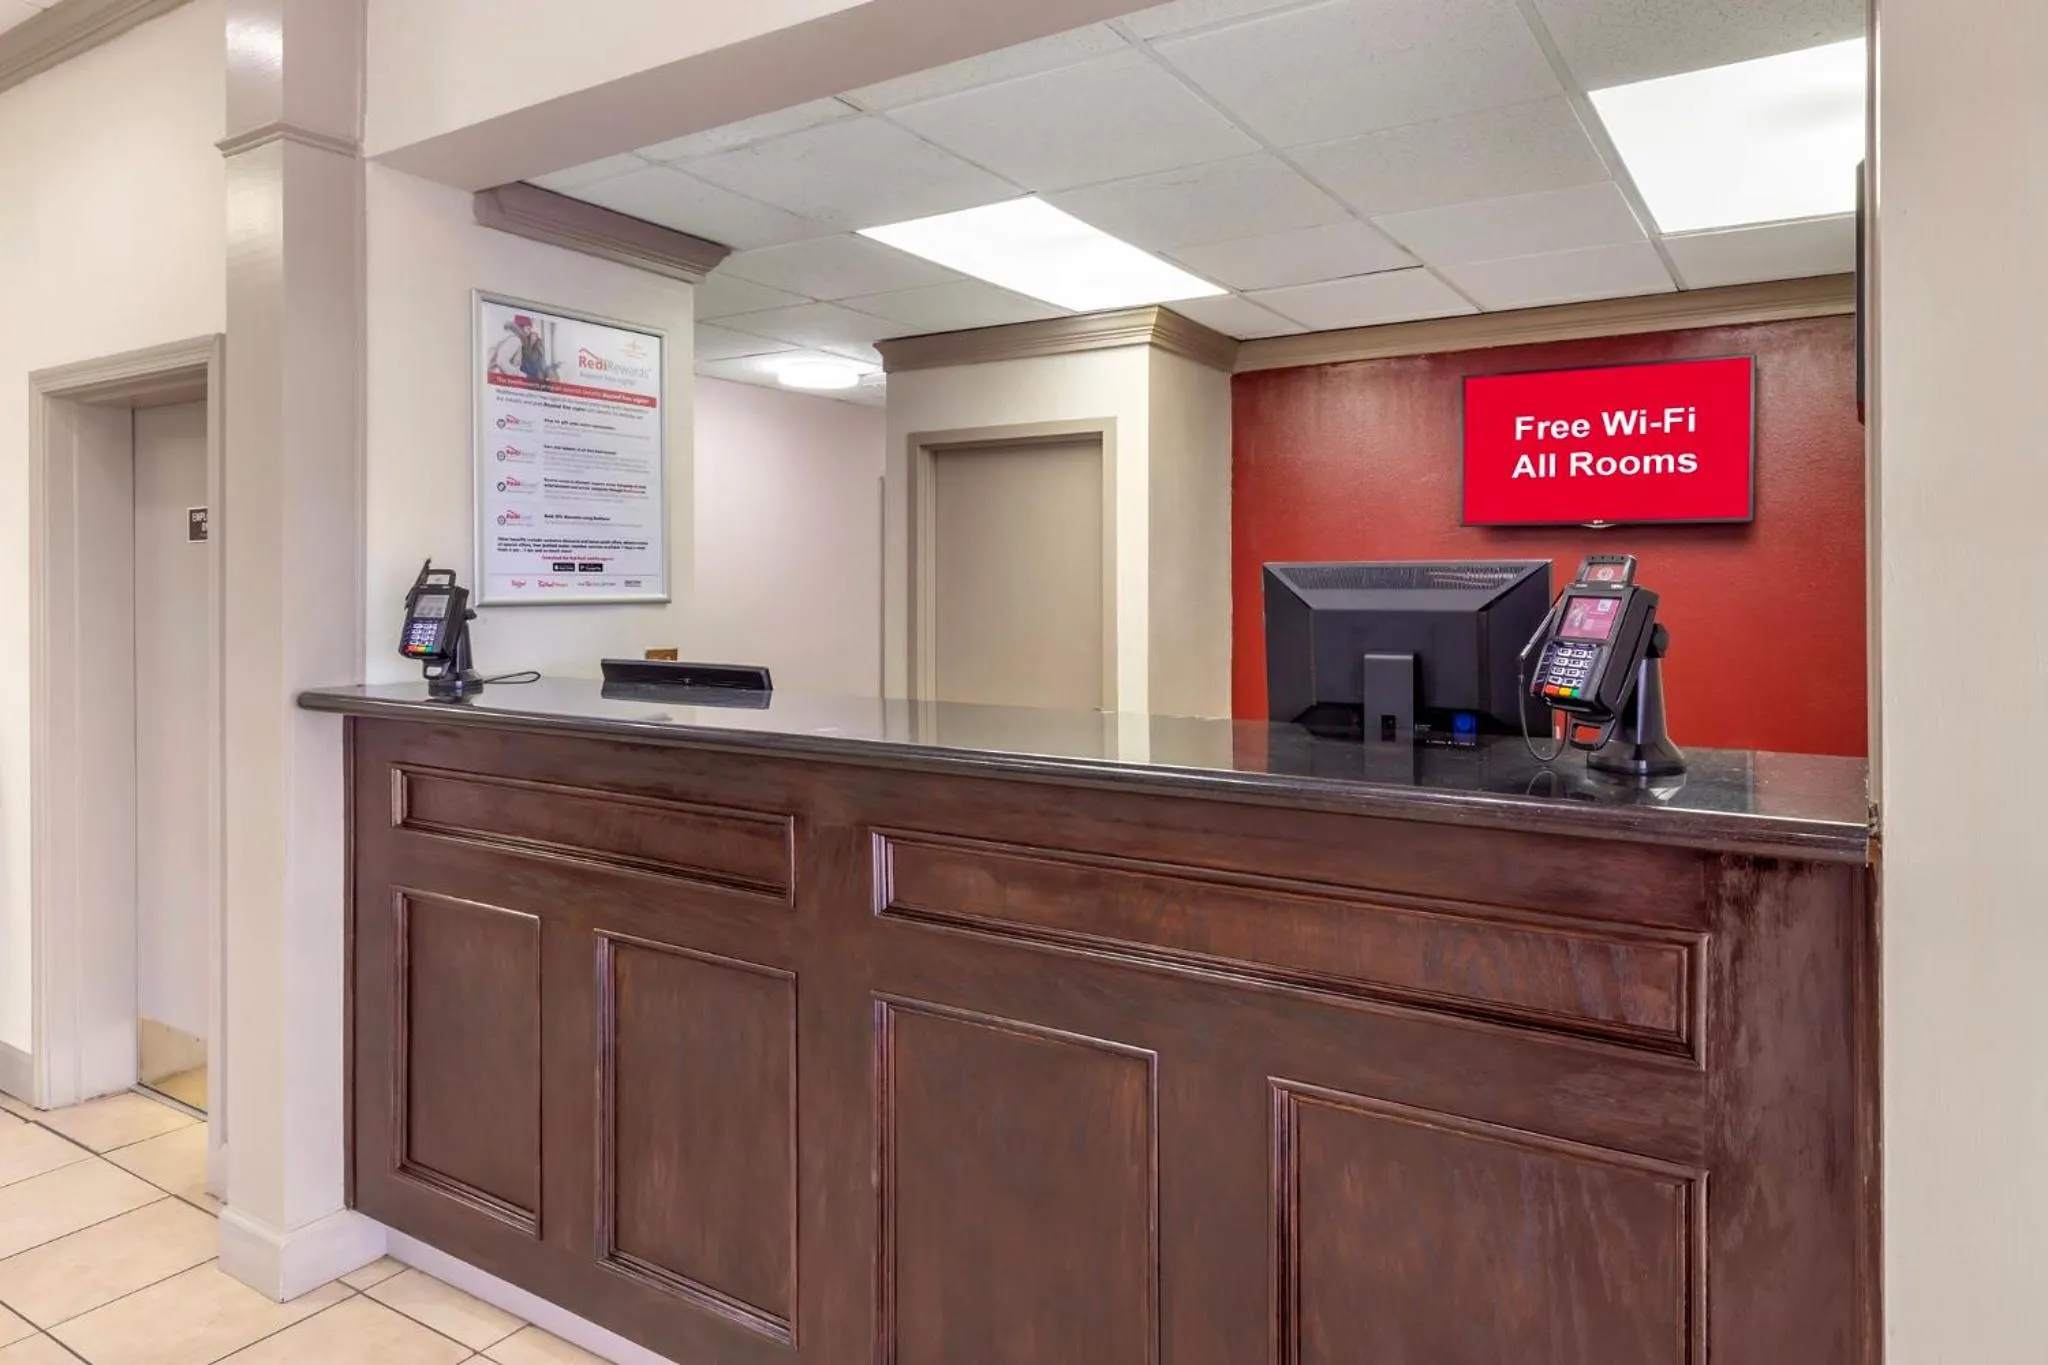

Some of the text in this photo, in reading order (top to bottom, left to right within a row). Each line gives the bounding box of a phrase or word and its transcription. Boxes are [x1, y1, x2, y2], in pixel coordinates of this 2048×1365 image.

[1515, 406, 1696, 441] Free Wi-Fi
[1511, 451, 1699, 479] All Rooms
